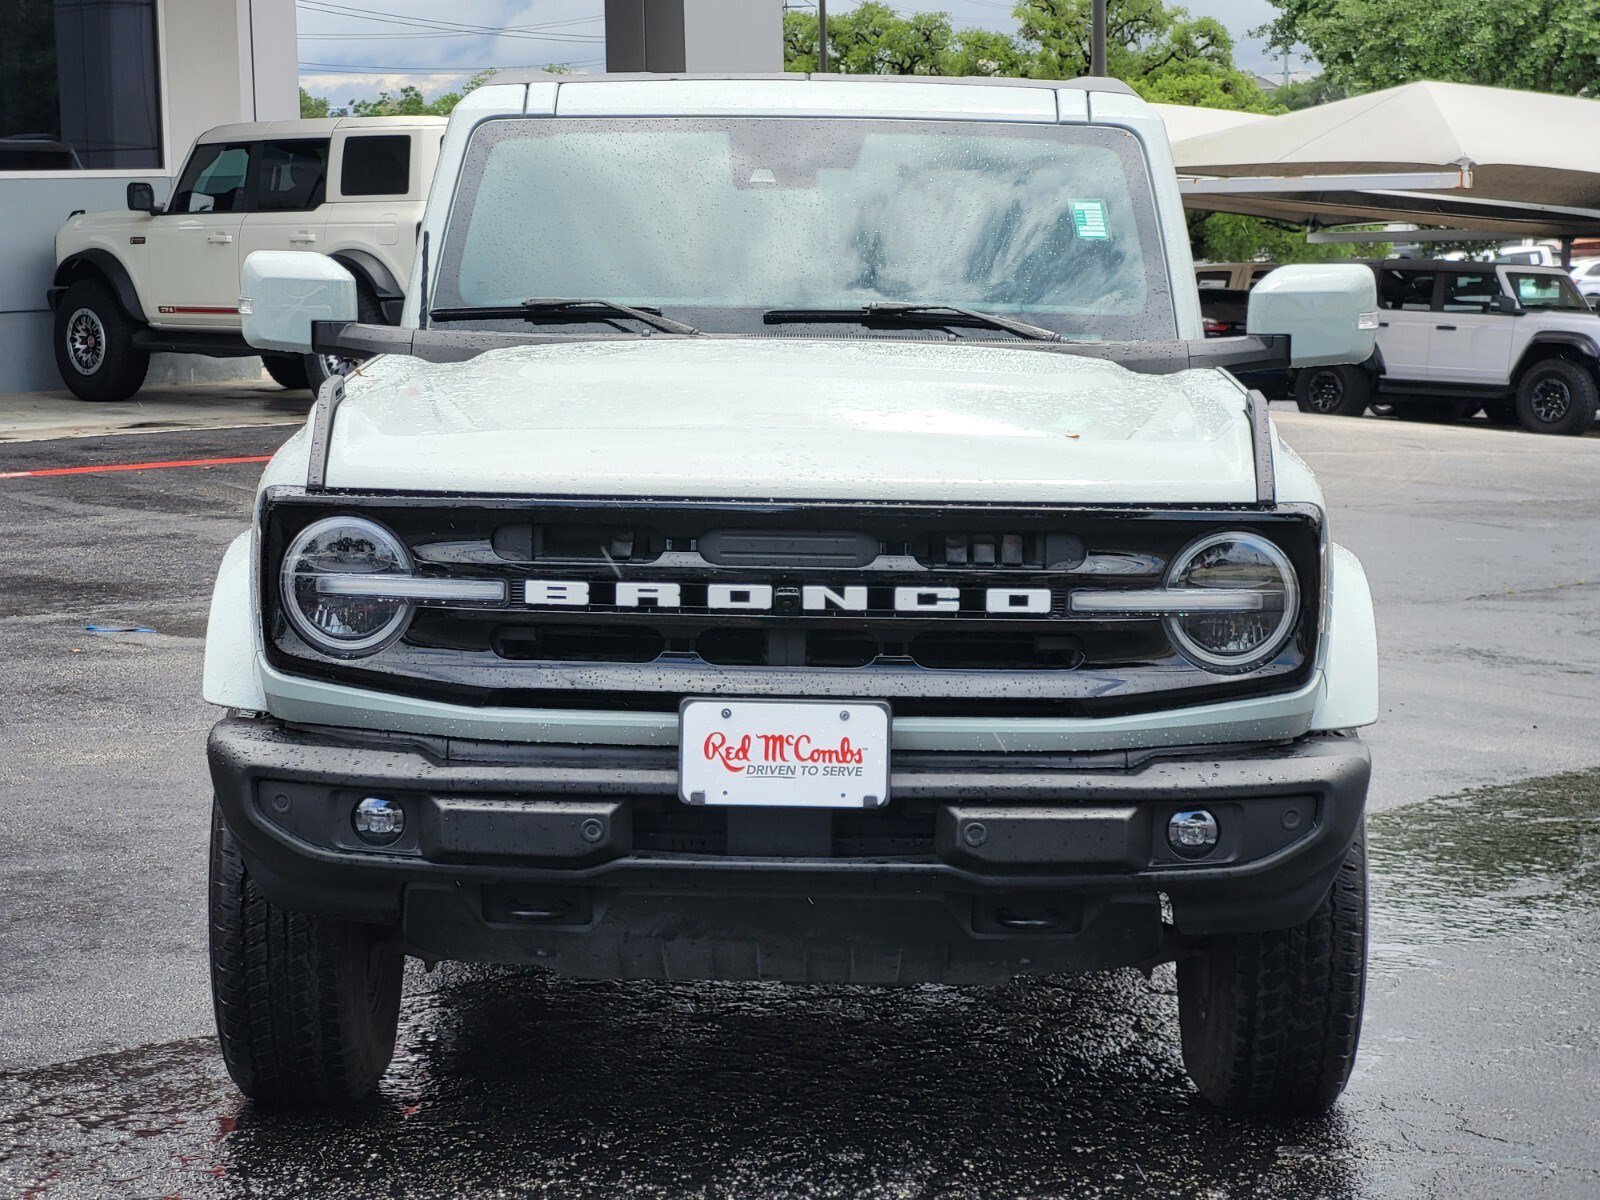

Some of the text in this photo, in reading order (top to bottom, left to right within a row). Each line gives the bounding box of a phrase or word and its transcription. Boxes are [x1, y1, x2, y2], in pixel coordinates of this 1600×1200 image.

[525, 580, 1051, 613] BRONCO
[704, 732, 863, 772] Red McCombs
[746, 765, 863, 777] DRIVEN TO SERVE
